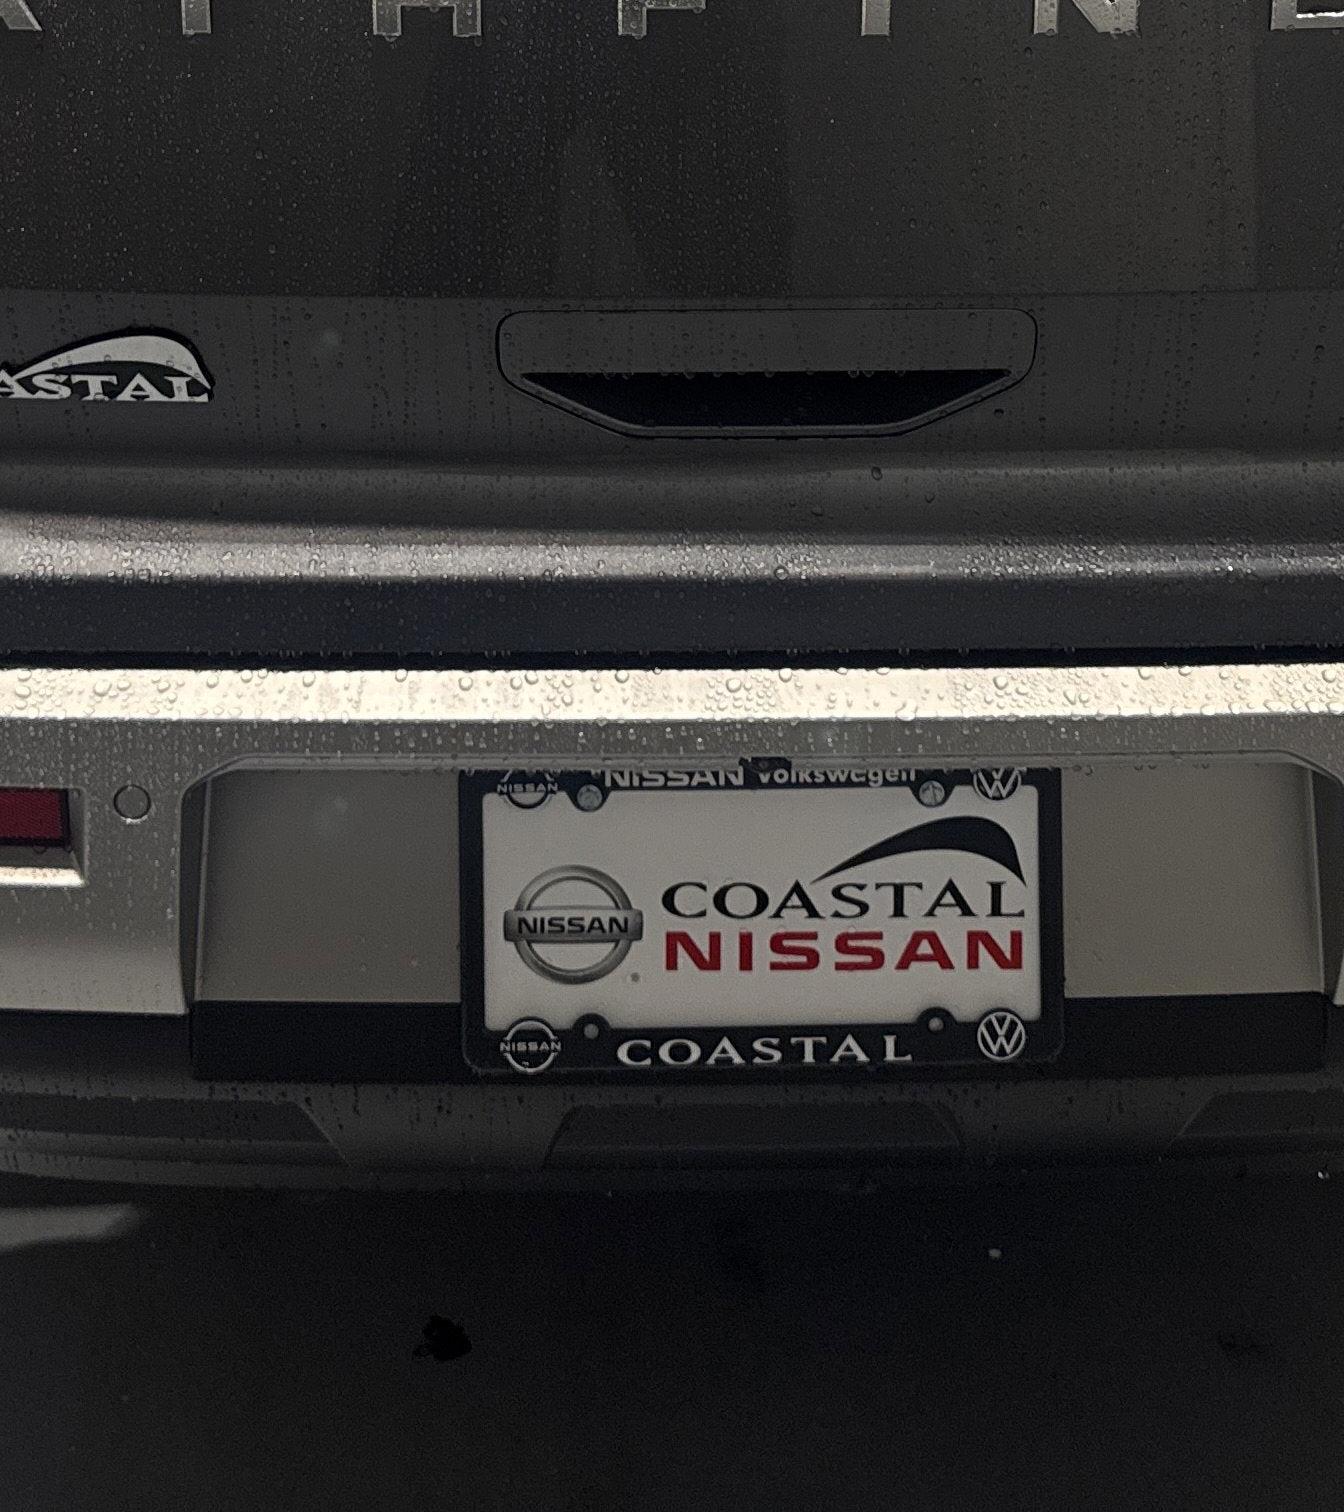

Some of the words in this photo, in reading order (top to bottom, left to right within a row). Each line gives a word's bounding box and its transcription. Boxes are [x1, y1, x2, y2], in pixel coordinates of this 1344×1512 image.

[605, 768, 743, 787] NISSAN
[661, 878, 1026, 919] COASTAL
[517, 917, 629, 934] NISSAN
[665, 931, 1023, 971] NISSAN
[500, 1041, 561, 1052] NISSAN
[616, 1034, 913, 1066] COASTAL
